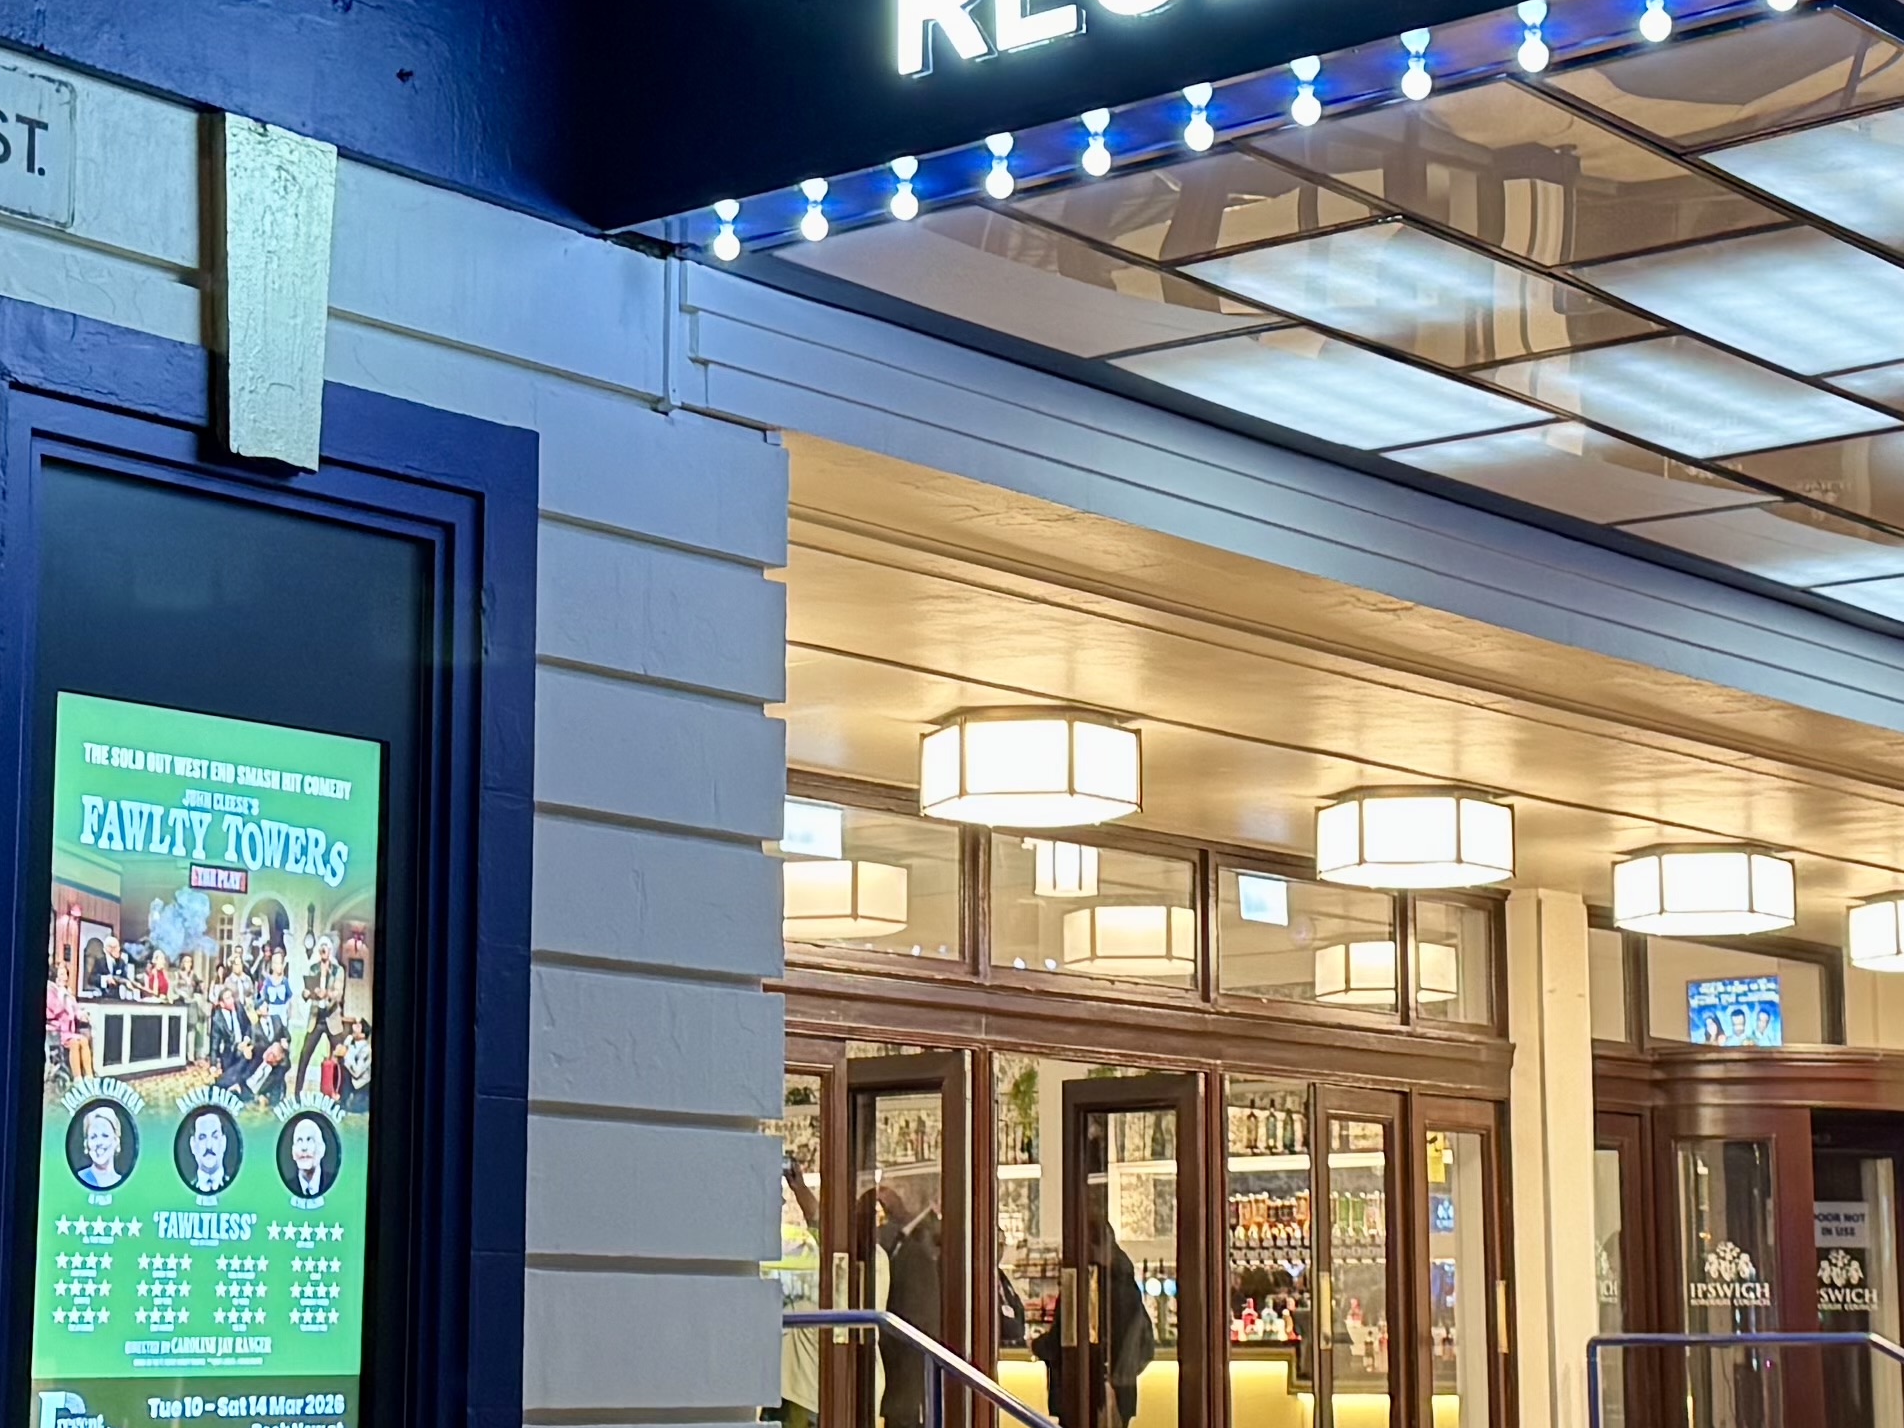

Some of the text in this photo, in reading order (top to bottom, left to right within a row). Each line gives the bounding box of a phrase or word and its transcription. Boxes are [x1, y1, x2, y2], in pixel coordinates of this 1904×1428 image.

[82, 742, 352, 800] THE SOLD OUT WEST END SMASH HIT COMEDY
[80, 794, 349, 888] FAWLTY TOWERS
[1690, 1282, 1770, 1299] IPSWICH
[148, 1397, 183, 1419] Tue
[183, 1396, 205, 1418] 10
[217, 1396, 248, 1418] Sat
[249, 1395, 268, 1417] 14
[269, 1395, 306, 1417] Mar
